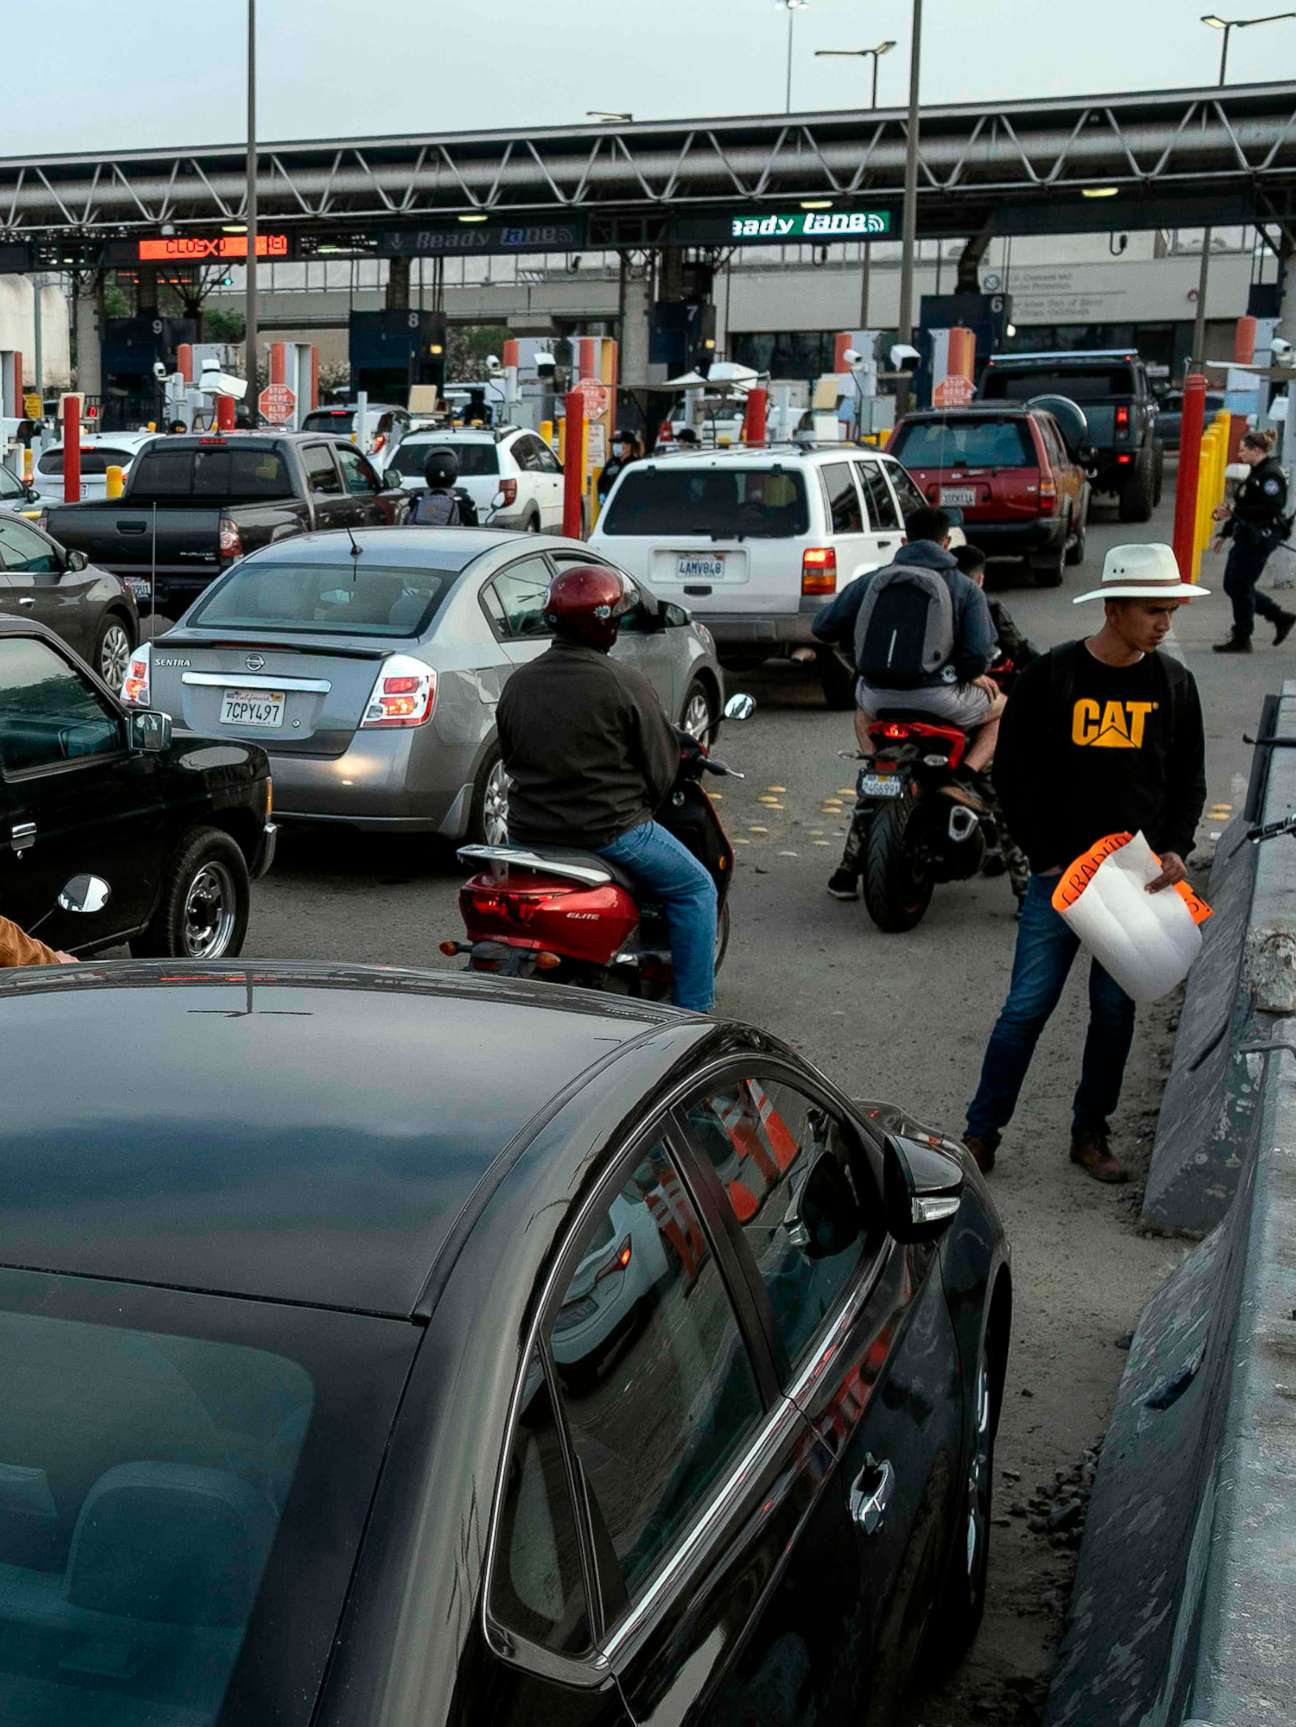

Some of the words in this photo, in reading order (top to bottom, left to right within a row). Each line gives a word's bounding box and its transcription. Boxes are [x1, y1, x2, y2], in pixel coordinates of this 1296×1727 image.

[416, 230, 491, 249] Ready
[991, 296, 1003, 313] 6
[408, 312, 420, 328] 8
[686, 305, 699, 322] 7
[151, 320, 163, 334] 9
[679, 562, 722, 576] 4AMV848
[154, 659, 192, 668] SENTRA
[225, 701, 281, 723] 7CPY497
[1071, 697, 1153, 750] CAT
[565, 911, 601, 921] ELITE
